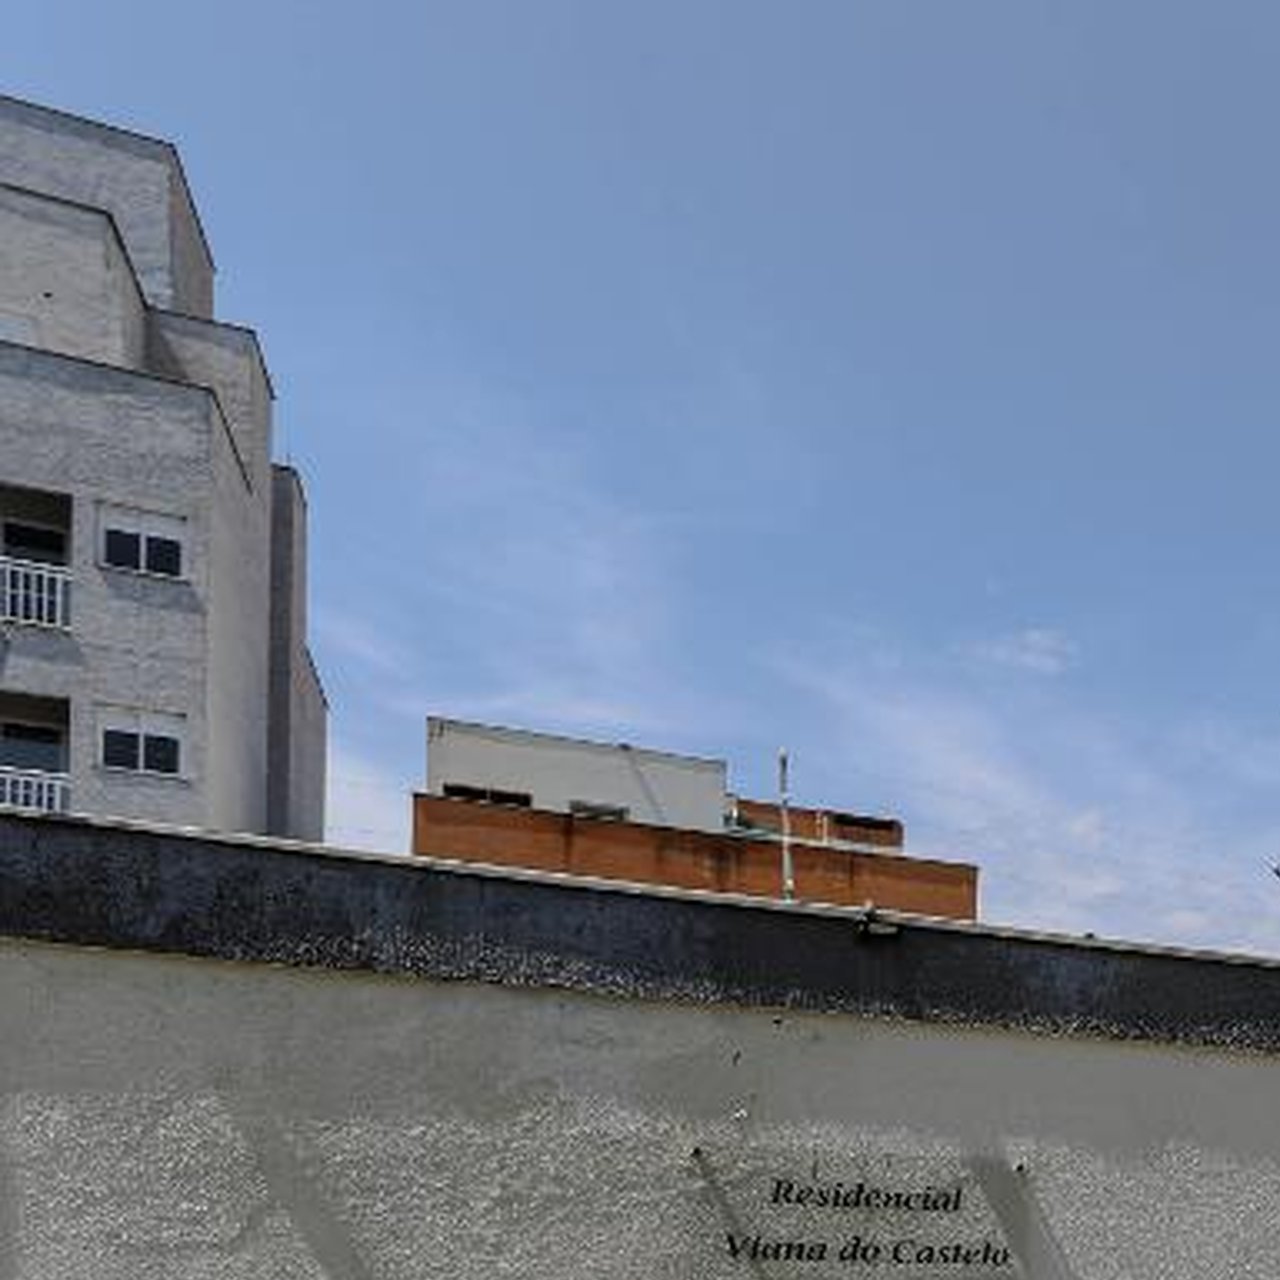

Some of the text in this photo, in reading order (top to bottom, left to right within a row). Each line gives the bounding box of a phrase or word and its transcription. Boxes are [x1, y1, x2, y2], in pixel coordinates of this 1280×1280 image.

[770, 1178, 963, 1212] Residencial
[726, 1234, 1011, 1268] Viana do Castelo
